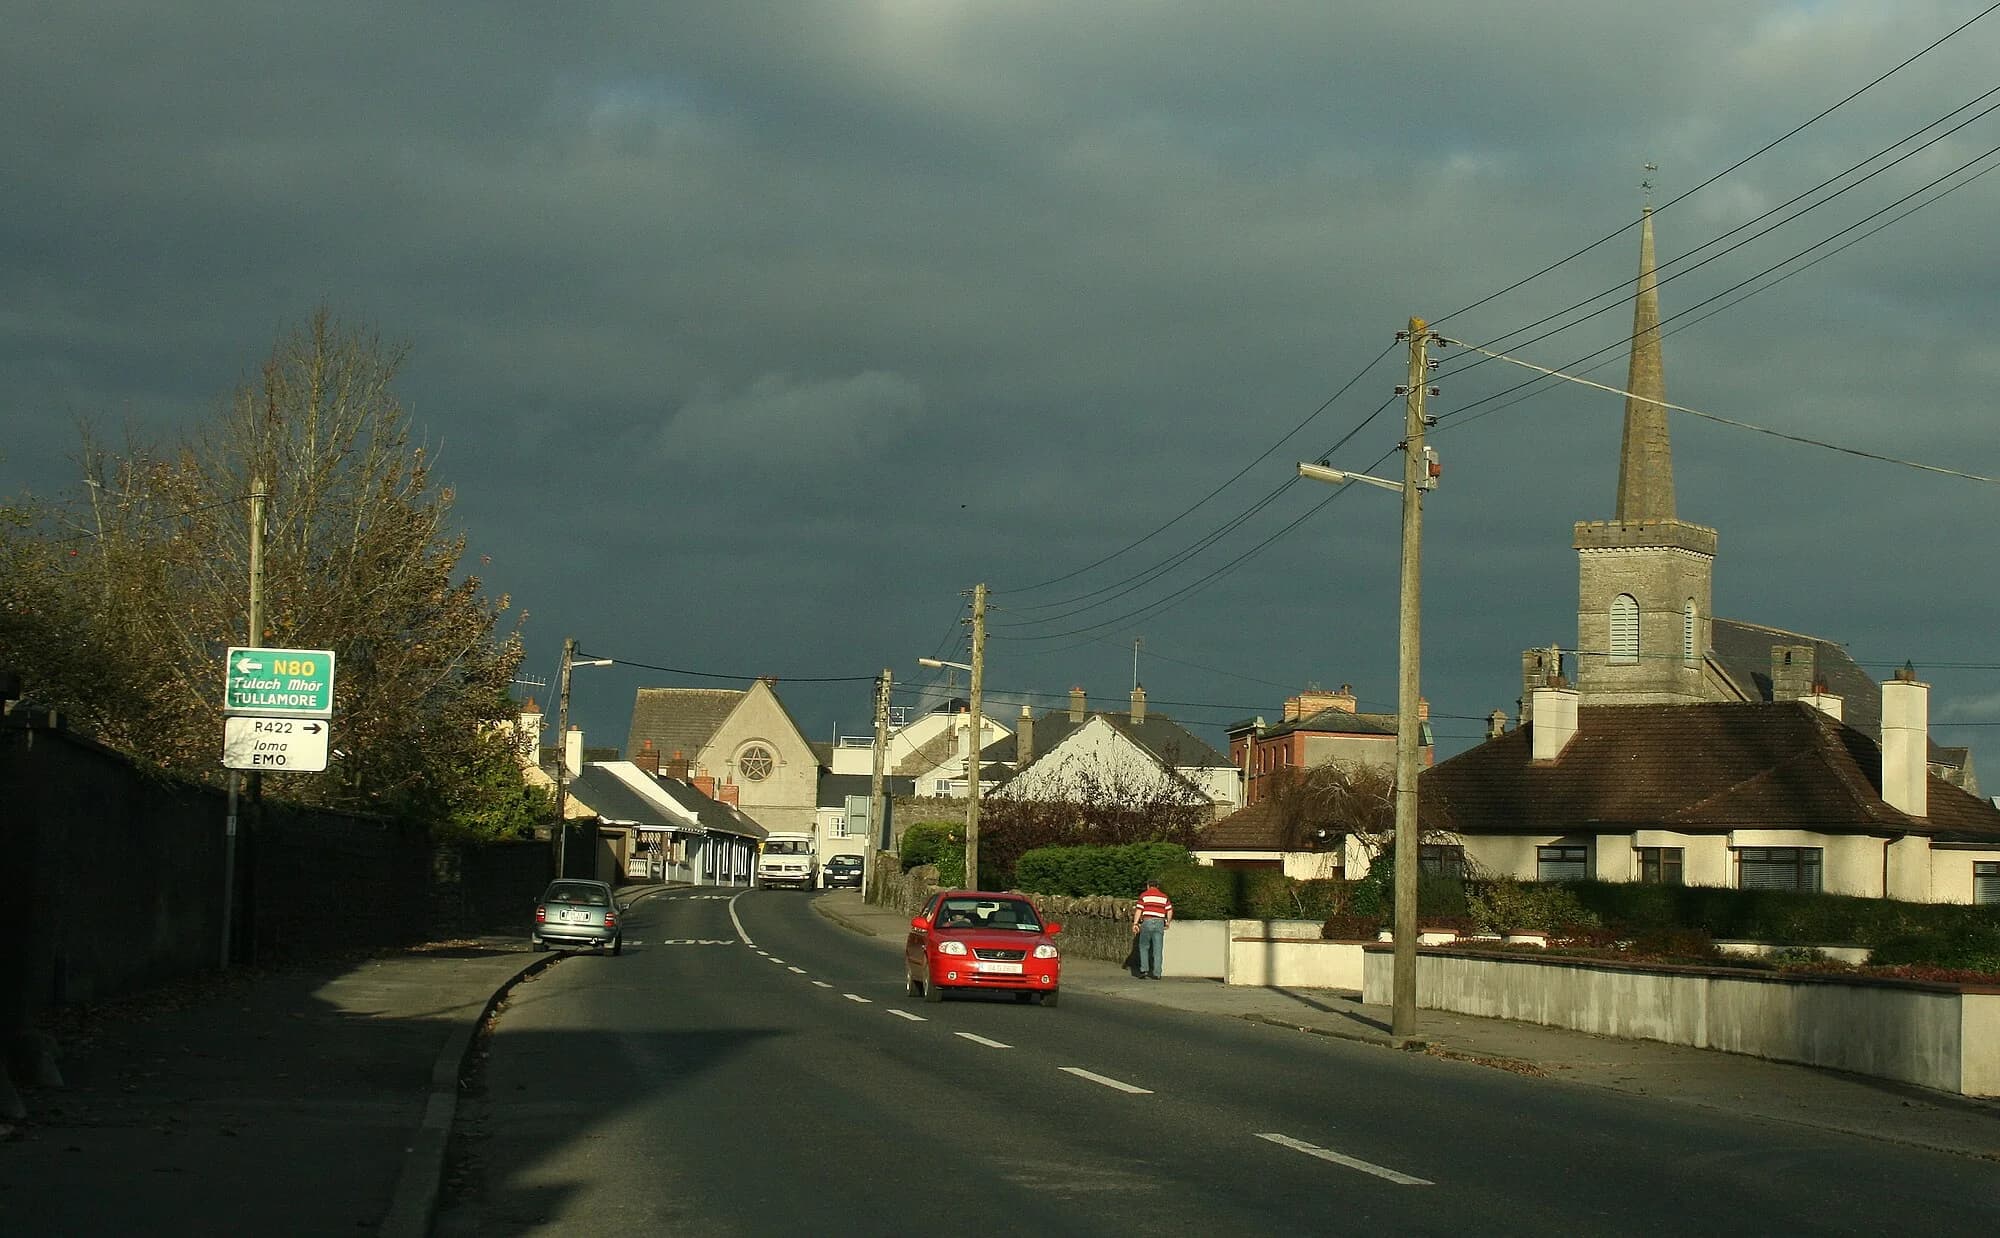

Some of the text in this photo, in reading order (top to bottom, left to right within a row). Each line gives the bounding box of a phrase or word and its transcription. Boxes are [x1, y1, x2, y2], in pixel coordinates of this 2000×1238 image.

[274, 660, 315, 676] N80
[233, 677, 281, 690] Tulach
[234, 693, 317, 706] TULLAMORE
[254, 722, 293, 734] R422
[253, 754, 286, 765] EMO
